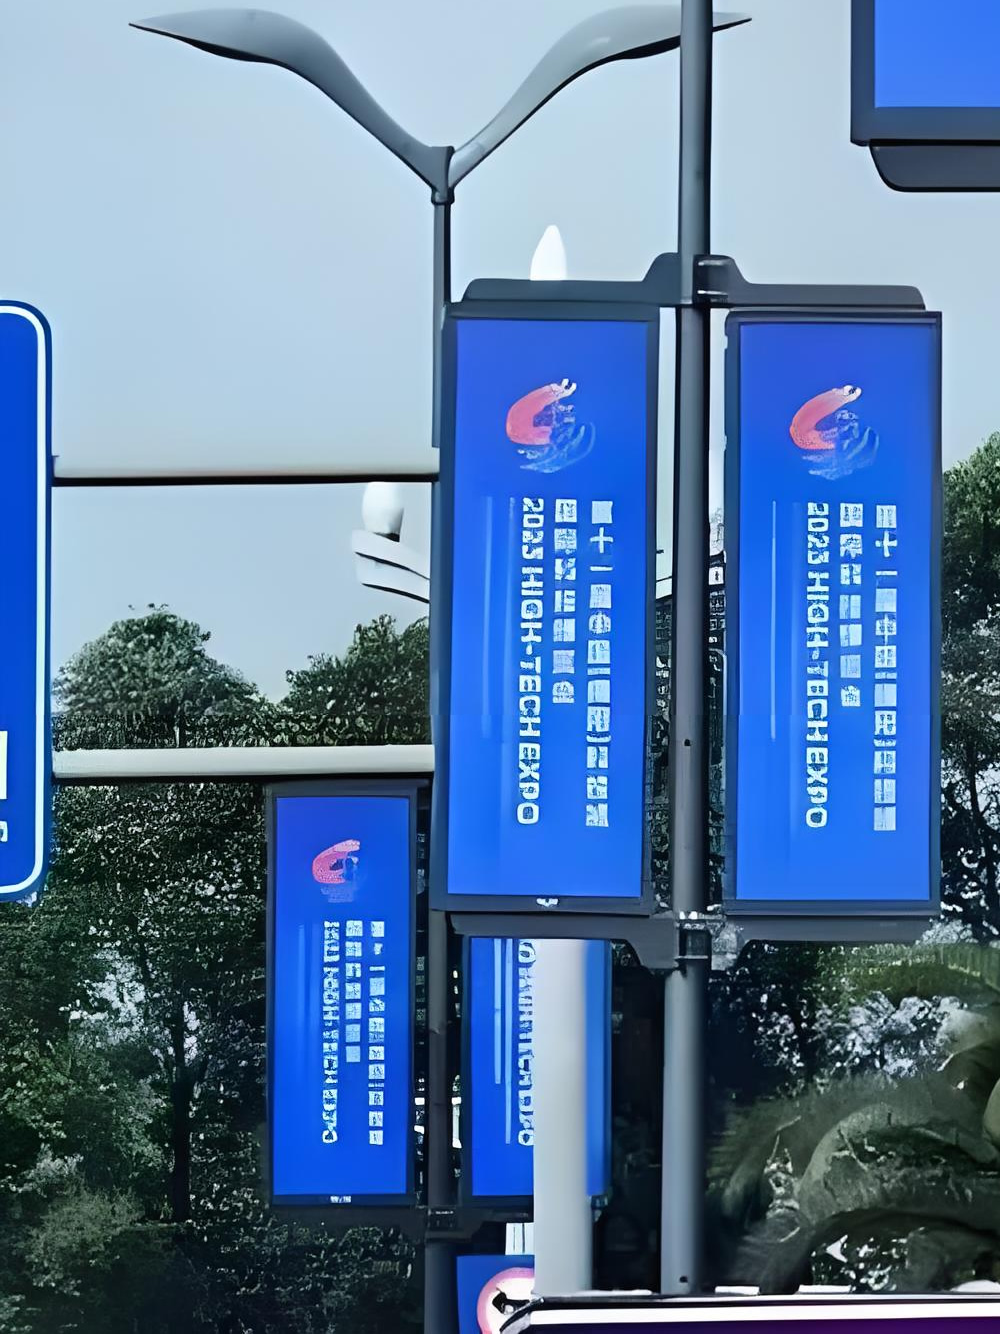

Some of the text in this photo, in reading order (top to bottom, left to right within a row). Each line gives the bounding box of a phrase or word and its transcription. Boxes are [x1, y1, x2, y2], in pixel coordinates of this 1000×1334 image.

[519, 566, 544, 737] HIGH-TECH
[805, 571, 830, 742] HIGH-TECH
[517, 742, 542, 825] EXPO
[805, 747, 829, 828] EXPO
